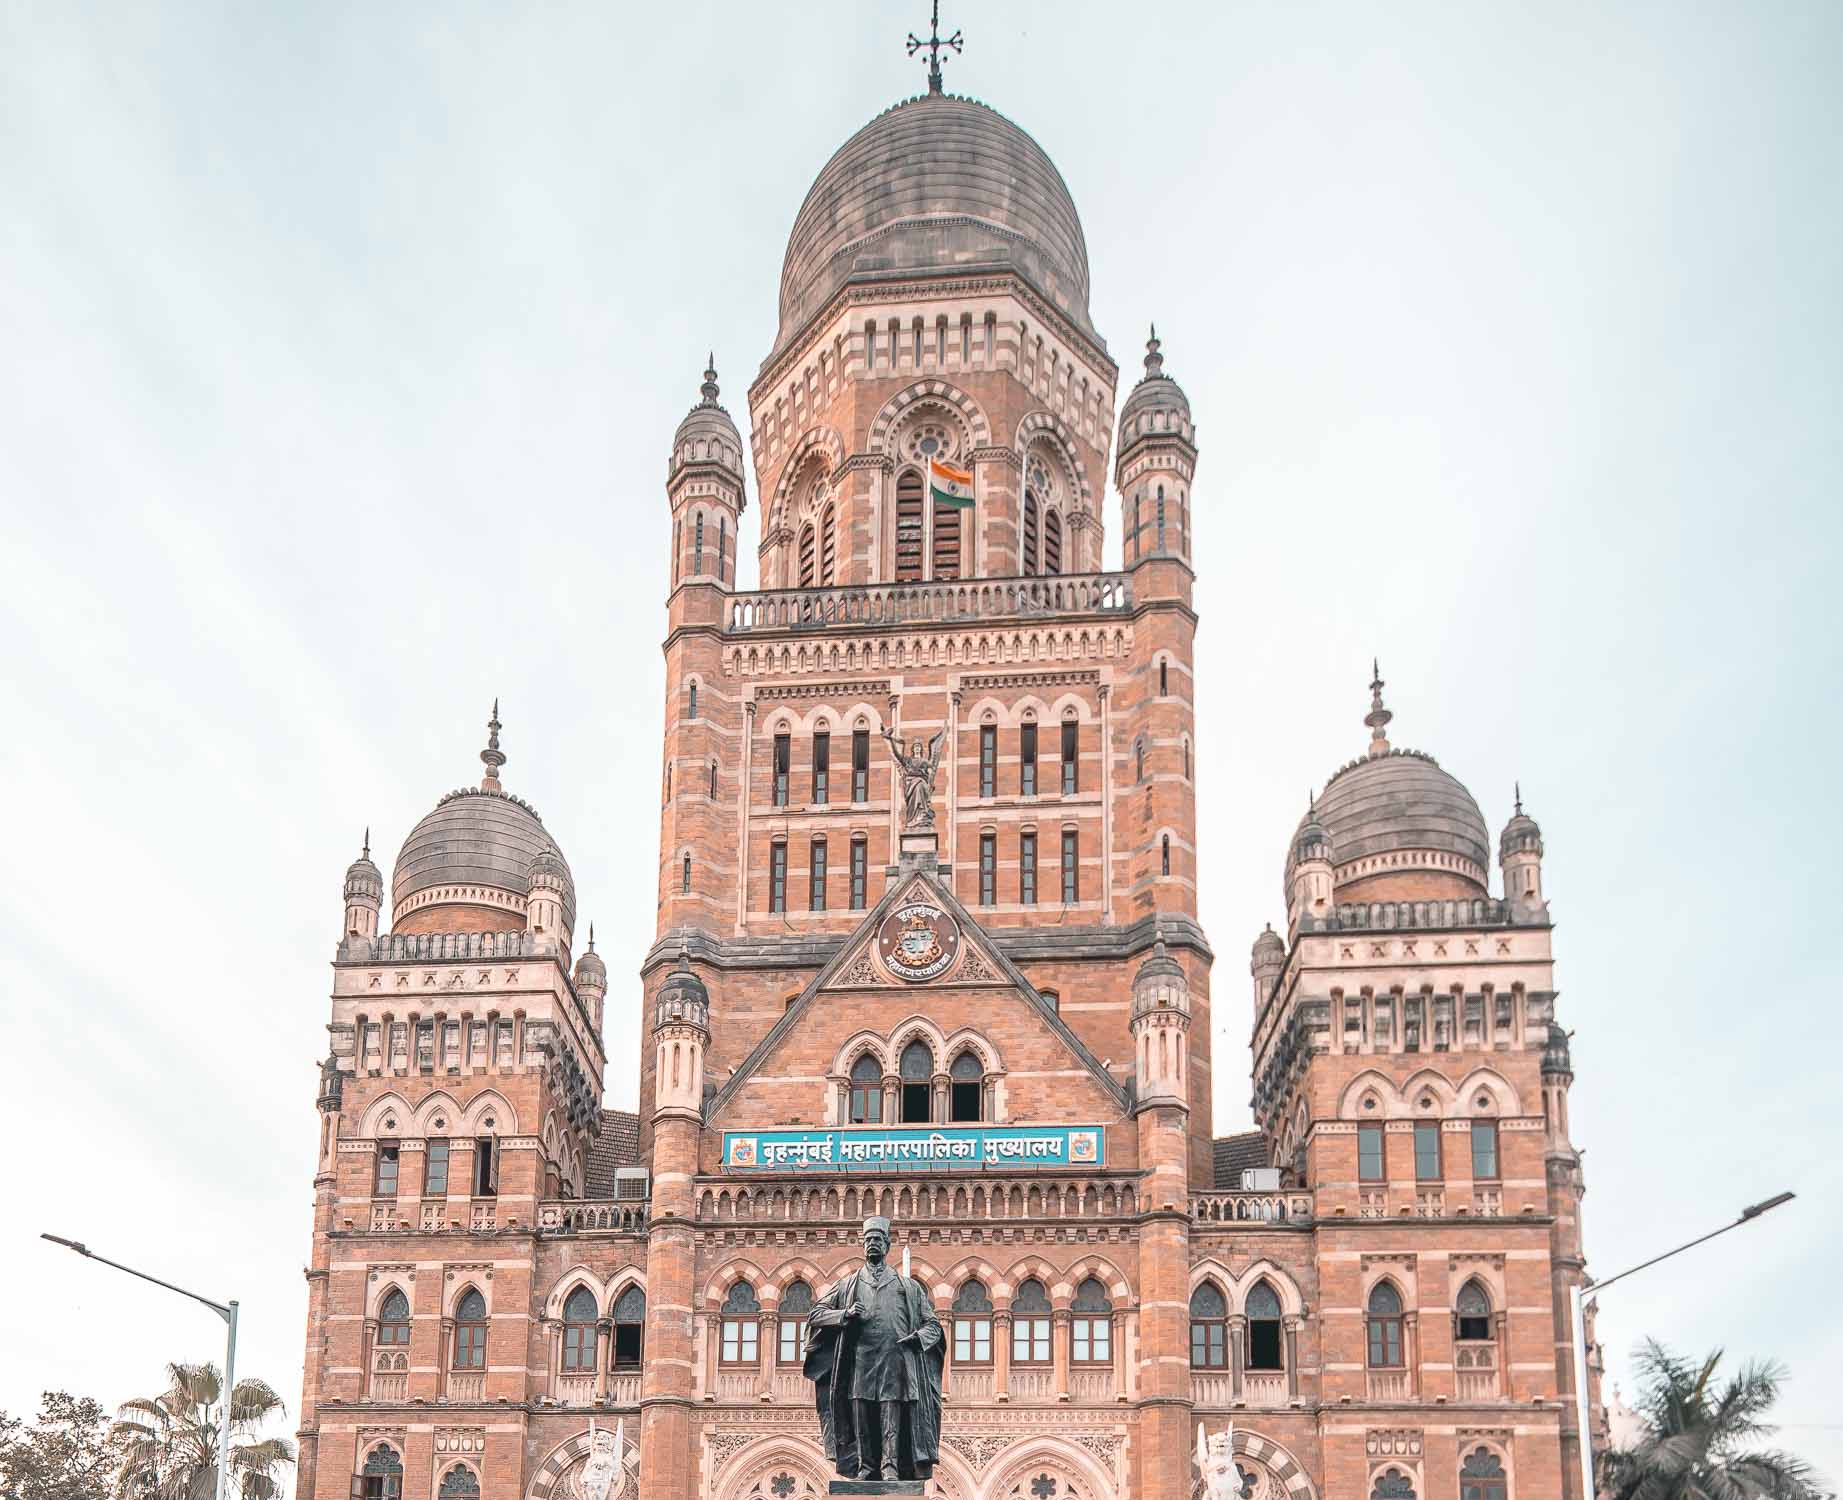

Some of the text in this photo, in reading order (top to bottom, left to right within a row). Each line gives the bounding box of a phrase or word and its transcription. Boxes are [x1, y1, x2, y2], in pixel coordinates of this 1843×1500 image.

[762, 1133, 1063, 1168] बृहन्मुंबई महानगरपालिका मुख्यालय
